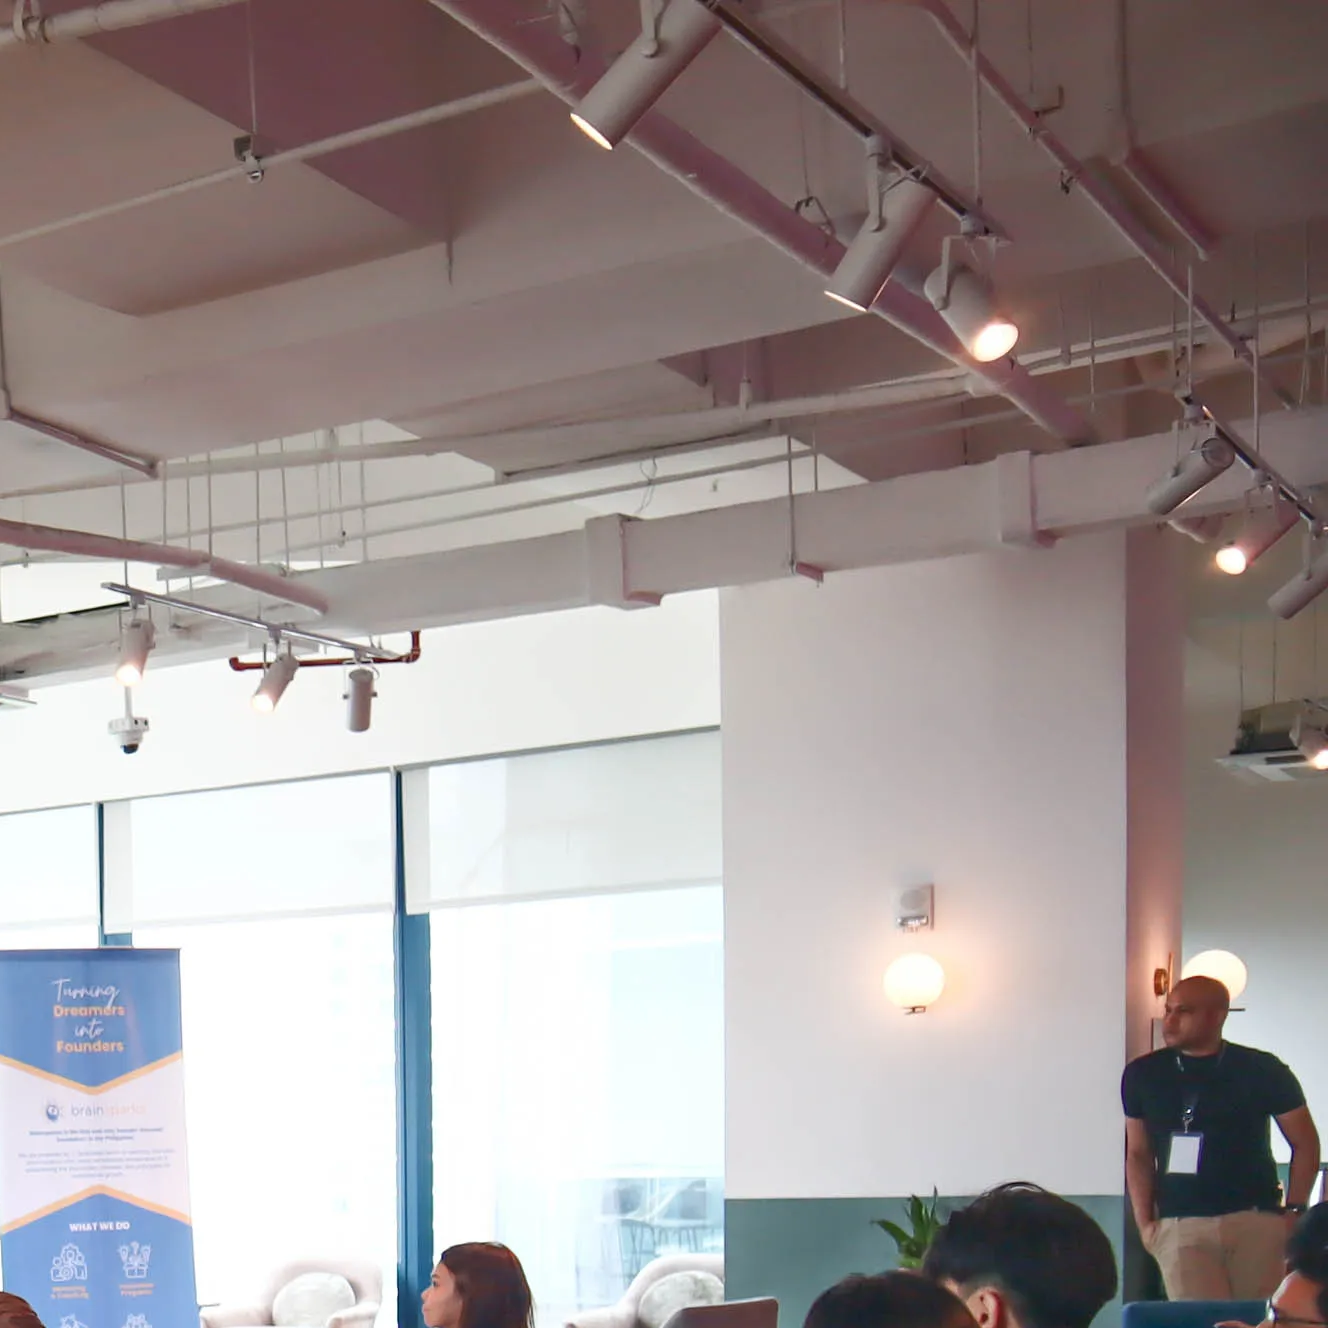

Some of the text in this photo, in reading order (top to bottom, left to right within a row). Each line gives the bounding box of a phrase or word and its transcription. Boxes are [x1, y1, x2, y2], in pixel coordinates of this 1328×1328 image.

[51, 978, 121, 1008] Turning
[53, 1004, 126, 1017] Dreamers
[74, 1018, 105, 1039] into
[56, 1040, 124, 1053] Founders
[68, 1221, 130, 1233] WHAT WE DO
